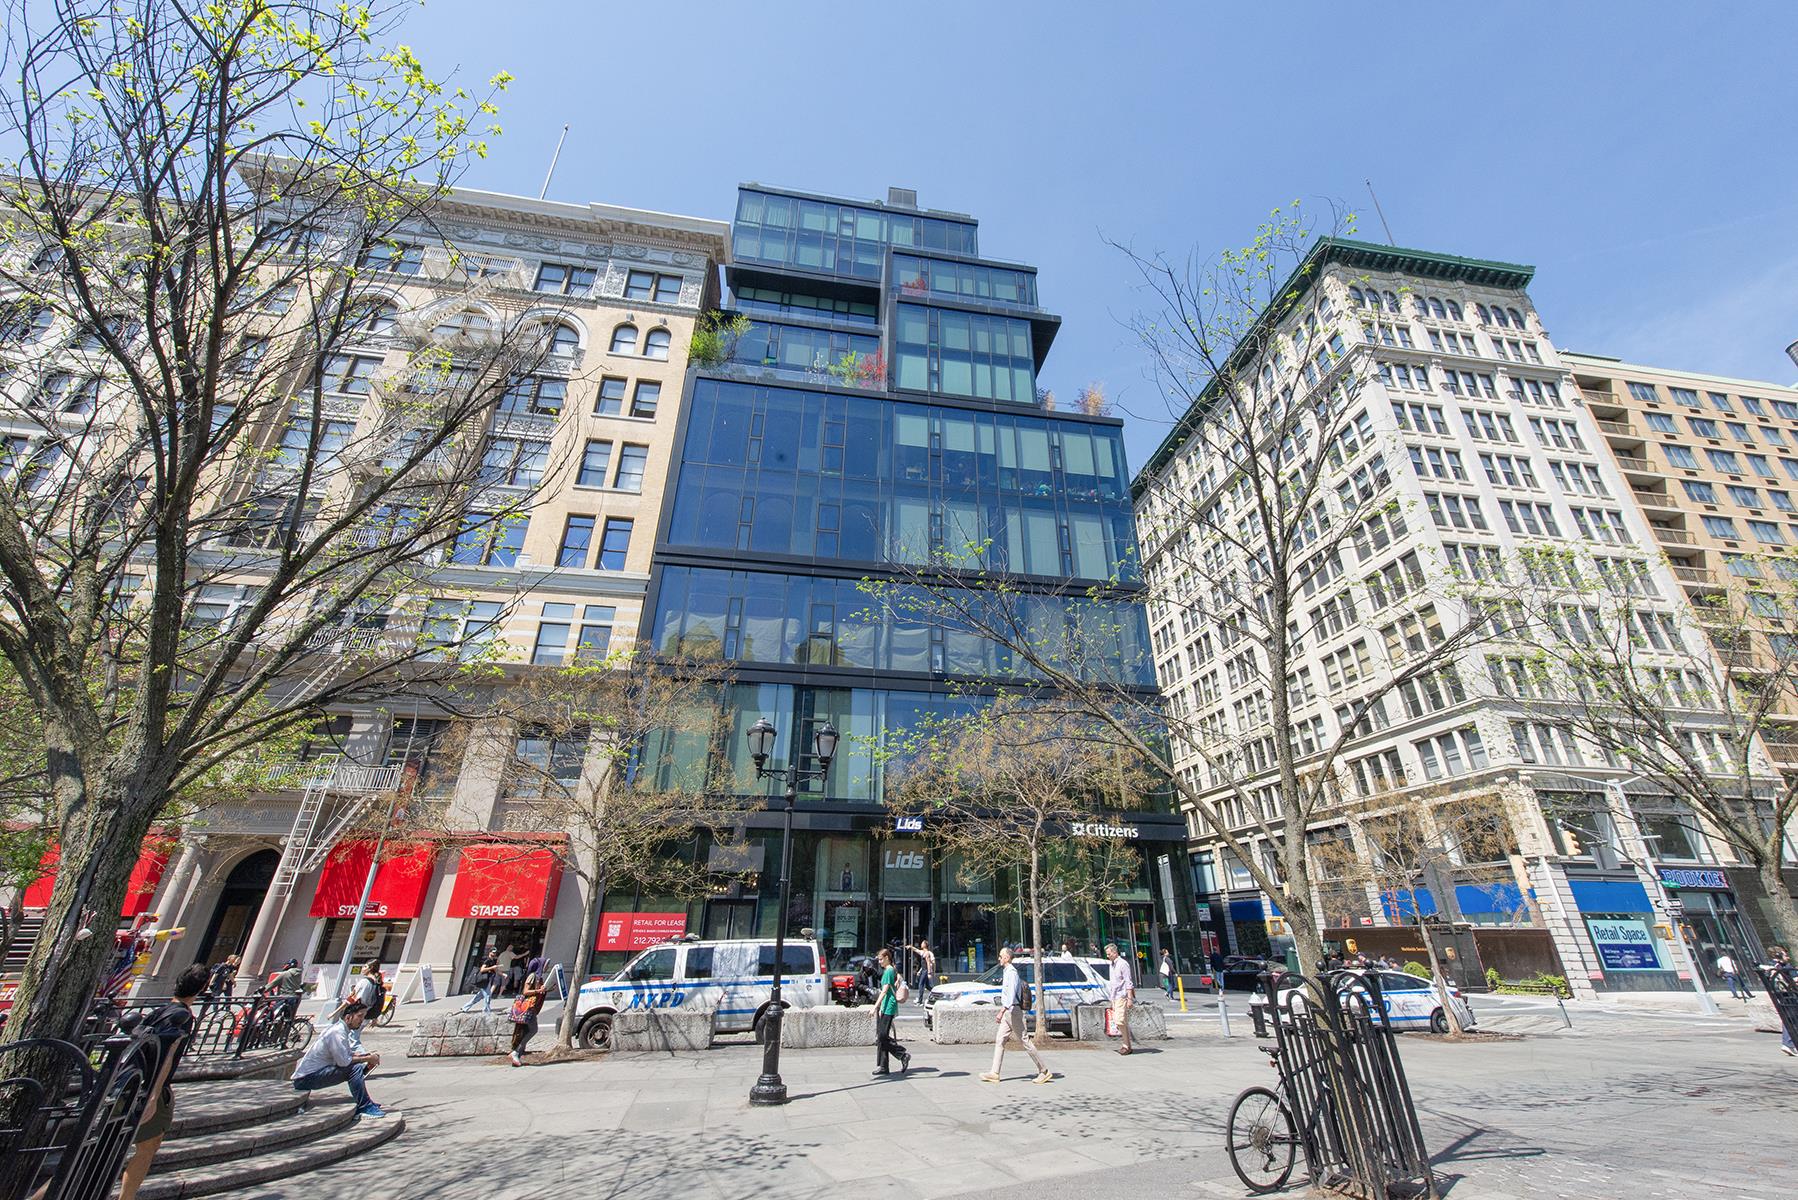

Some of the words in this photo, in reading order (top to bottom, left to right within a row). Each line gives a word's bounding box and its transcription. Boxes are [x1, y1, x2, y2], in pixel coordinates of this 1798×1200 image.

[896, 818, 922, 830] Lids
[1086, 824, 1139, 838] Citizens
[885, 850, 924, 868] Lids
[338, 904, 388, 916] STAS
[470, 905, 520, 917] STAPLES
[1593, 925, 1620, 940] Retail
[1620, 926, 1647, 943] Space
[628, 992, 685, 1008] NYPD
